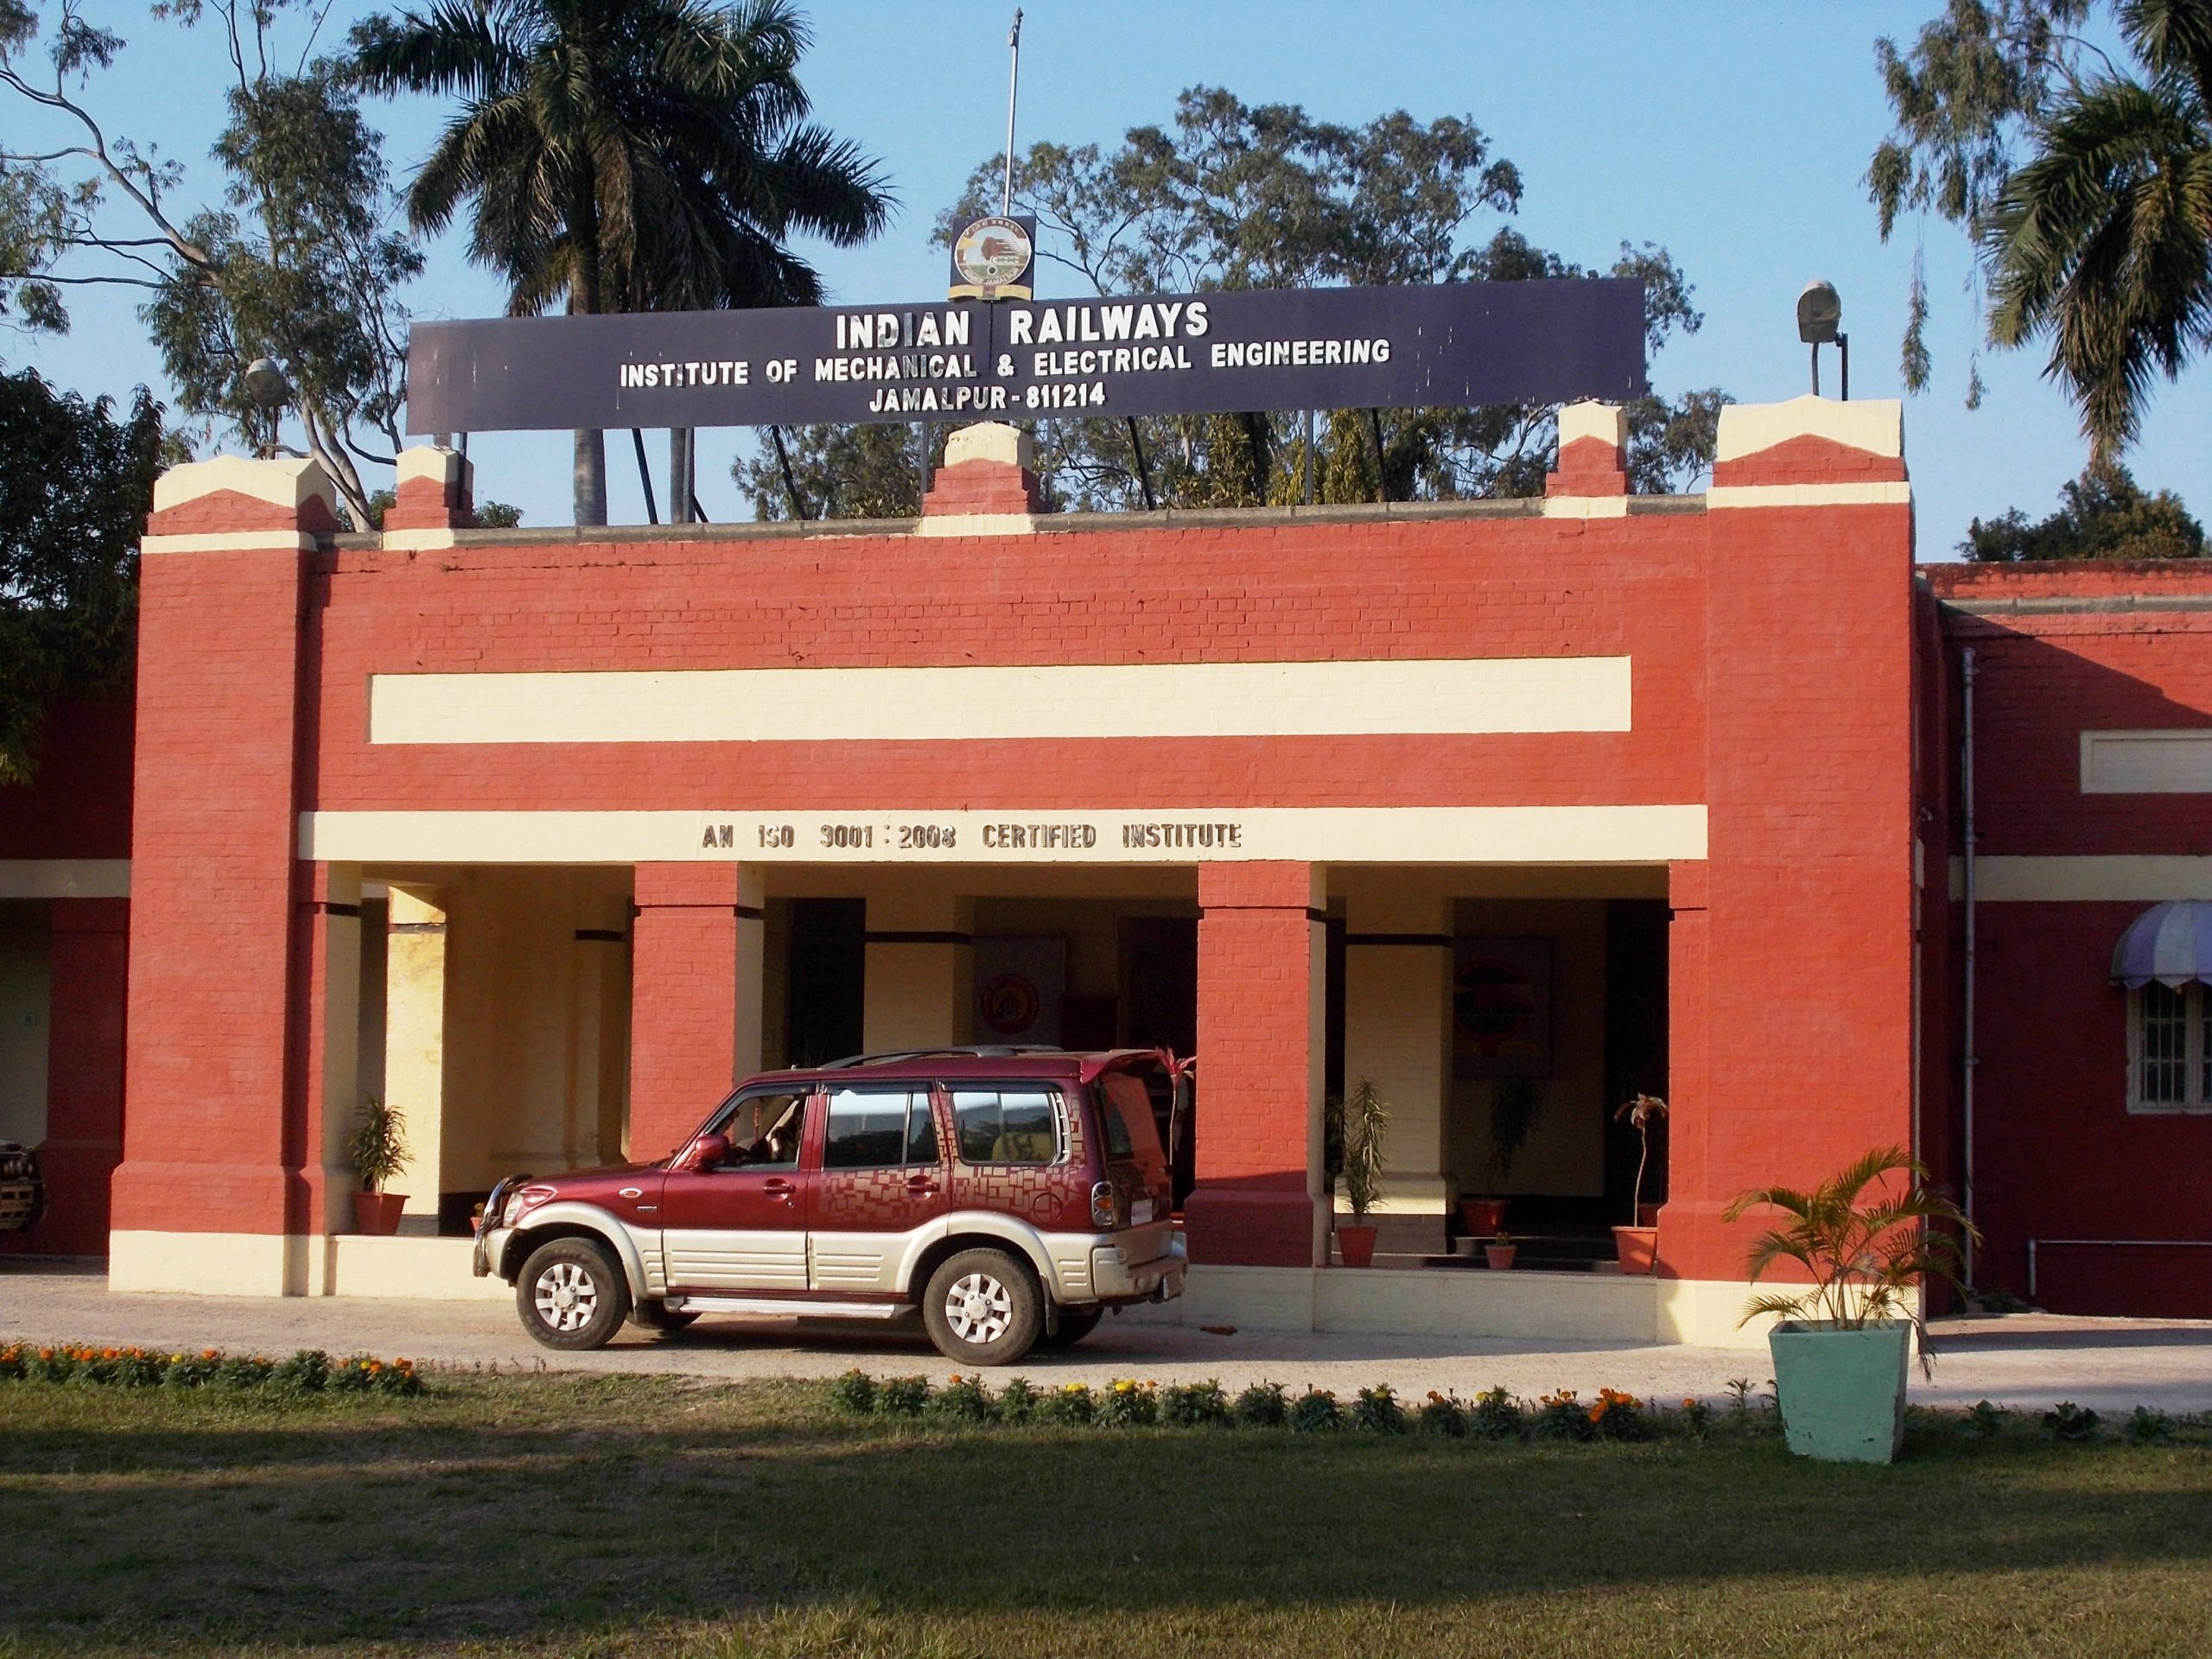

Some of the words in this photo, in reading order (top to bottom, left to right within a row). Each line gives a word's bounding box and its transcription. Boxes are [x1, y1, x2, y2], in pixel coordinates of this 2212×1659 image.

[836, 310, 970, 349] INDIAN
[1010, 301, 1209, 344] RAILWAYS
[620, 360, 749, 387] INSTITUTE
[766, 359, 798, 384] OF
[815, 353, 977, 381] MECHANICAL
[997, 353, 1014, 377] &
[1034, 345, 1192, 376] ELECTRICAL
[1211, 338, 1390, 367] ENGINEERING
[702, 824, 734, 849] AN
[758, 824, 795, 849] ISO
[982, 823, 1096, 849] CERTIFIED
[1122, 823, 1243, 849] INSTITUTE
